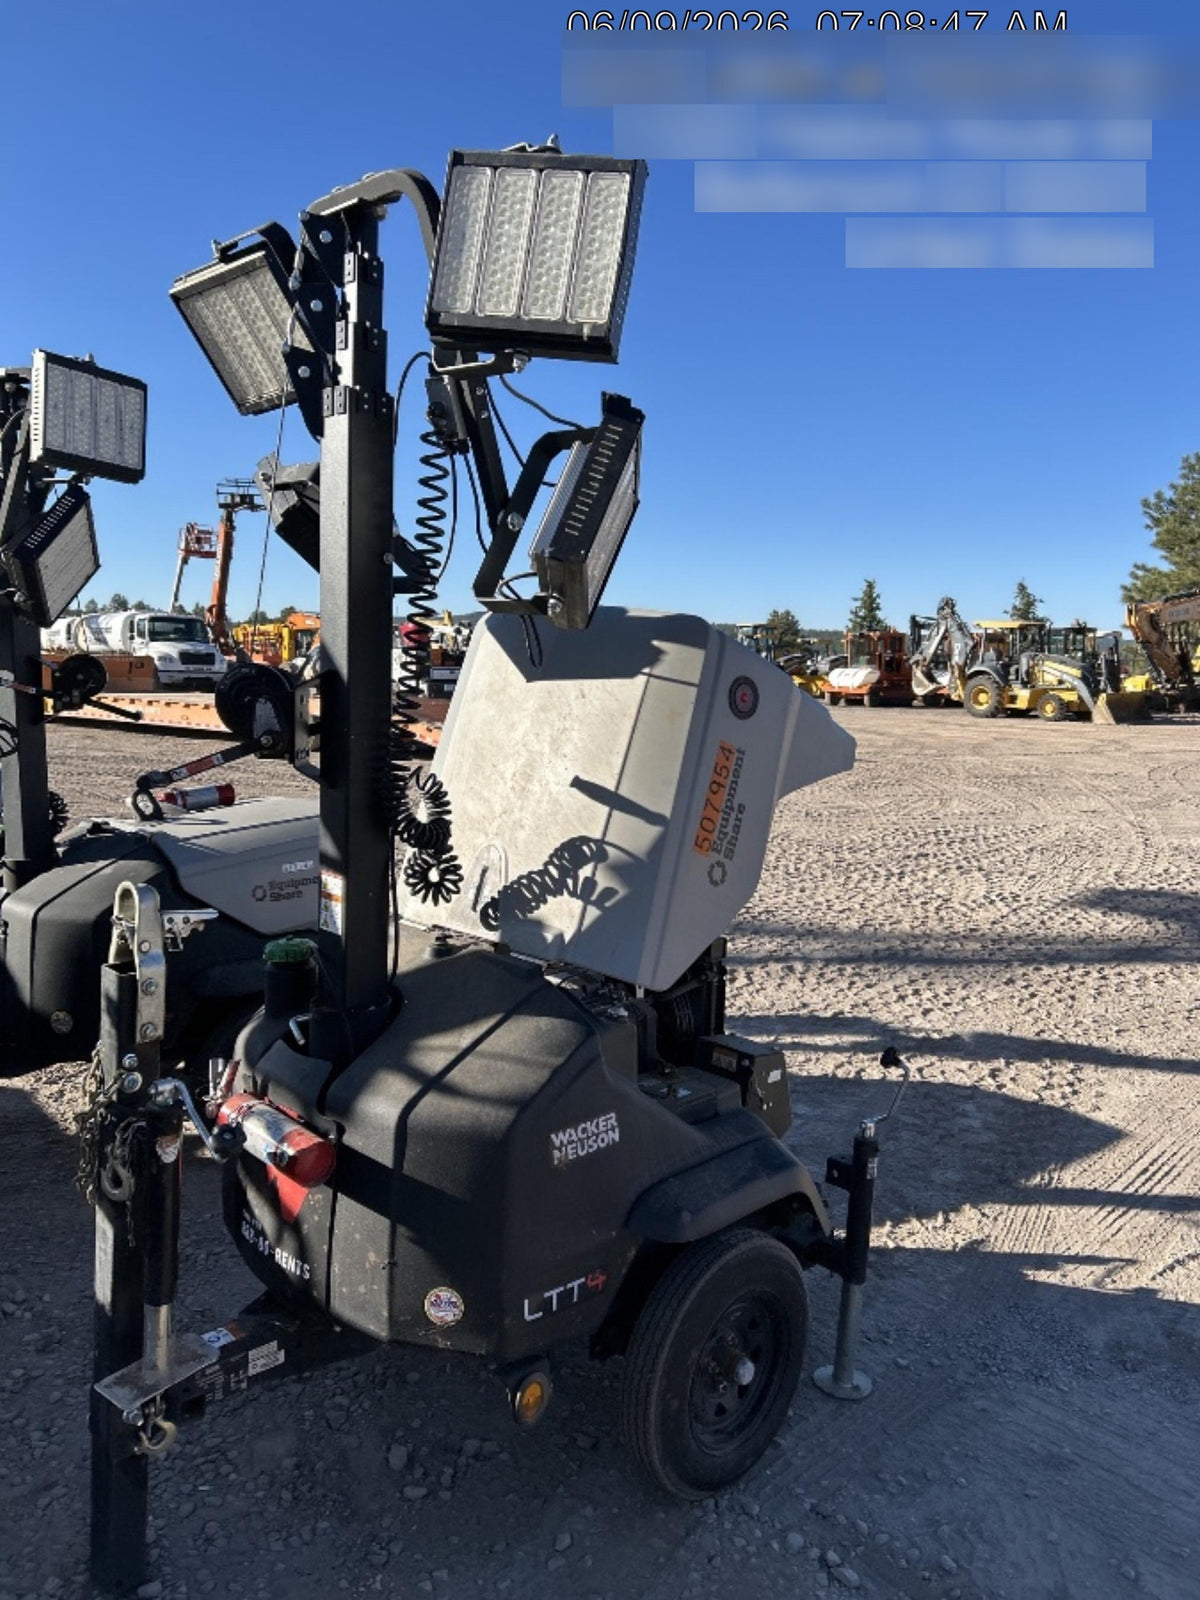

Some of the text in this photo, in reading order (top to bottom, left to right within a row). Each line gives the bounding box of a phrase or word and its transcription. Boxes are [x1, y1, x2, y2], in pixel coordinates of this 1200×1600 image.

[694, 744, 736, 852] 507954
[711, 746, 746, 855] Equipment
[723, 802, 747, 861] Share
[550, 1111, 619, 1148] WACKER
[552, 1126, 620, 1166] NEUSON
[523, 1268, 608, 1322] LTT4
